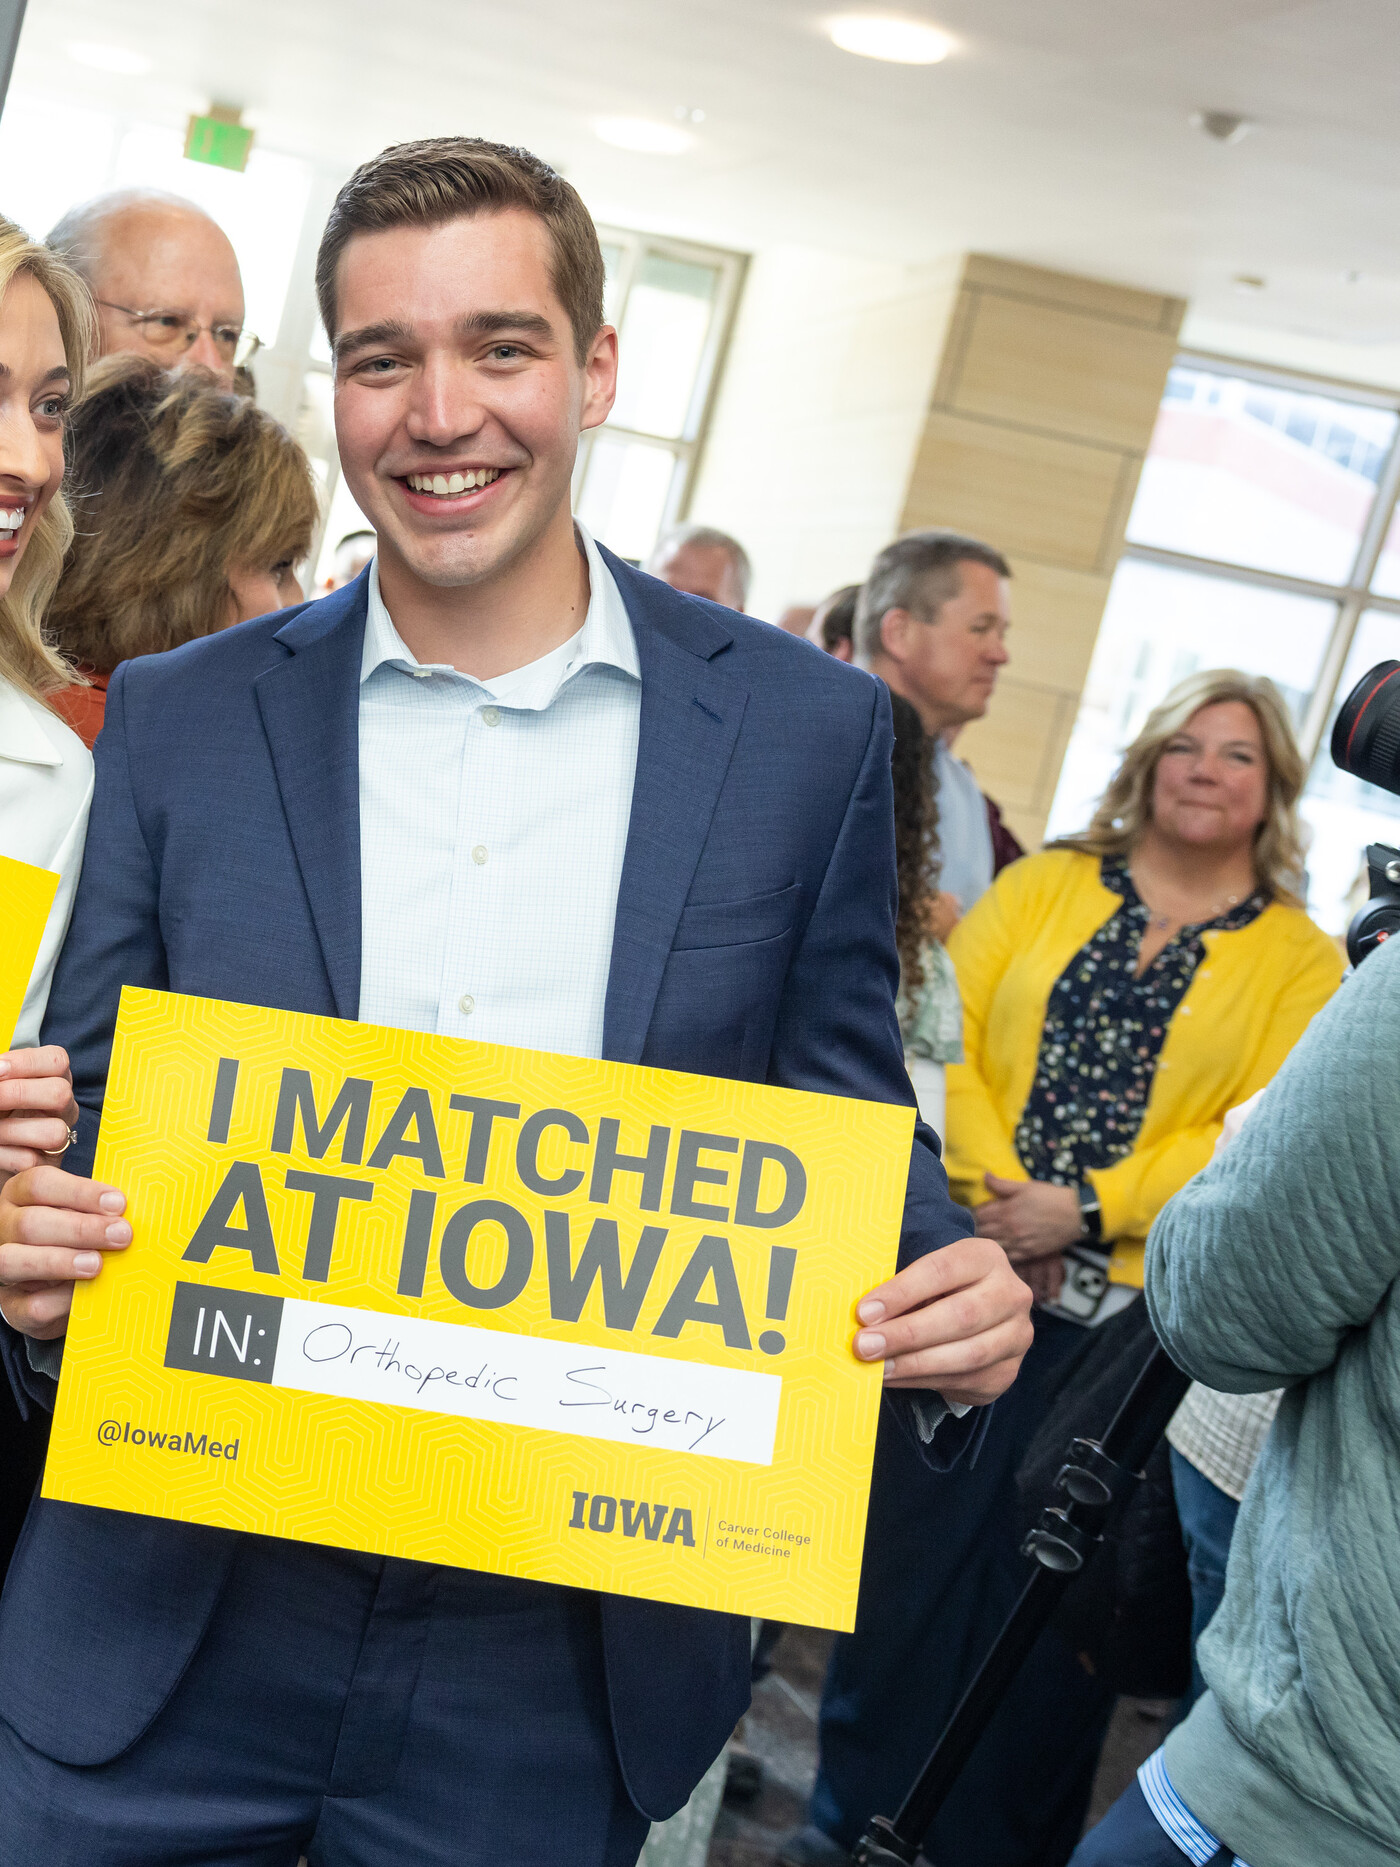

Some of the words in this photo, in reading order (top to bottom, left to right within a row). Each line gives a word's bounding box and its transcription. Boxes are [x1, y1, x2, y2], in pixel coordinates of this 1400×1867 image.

[208, 1058, 239, 1143] I
[271, 1068, 807, 1229] MATCHED
[181, 1161, 373, 1282] AT
[397, 1190, 797, 1356] IOWA!
[192, 1307, 266, 1366] IN:
[302, 1322, 518, 1401] Orthopedic
[558, 1366, 726, 1450] Surgery
[96, 1419, 240, 1461] @IowaMed
[568, 1491, 696, 1548] IOWA
[716, 1537, 730, 1548] of
[733, 1541, 791, 1558] Medicine
[718, 1520, 759, 1537] Carver
[763, 1528, 811, 1546] College
